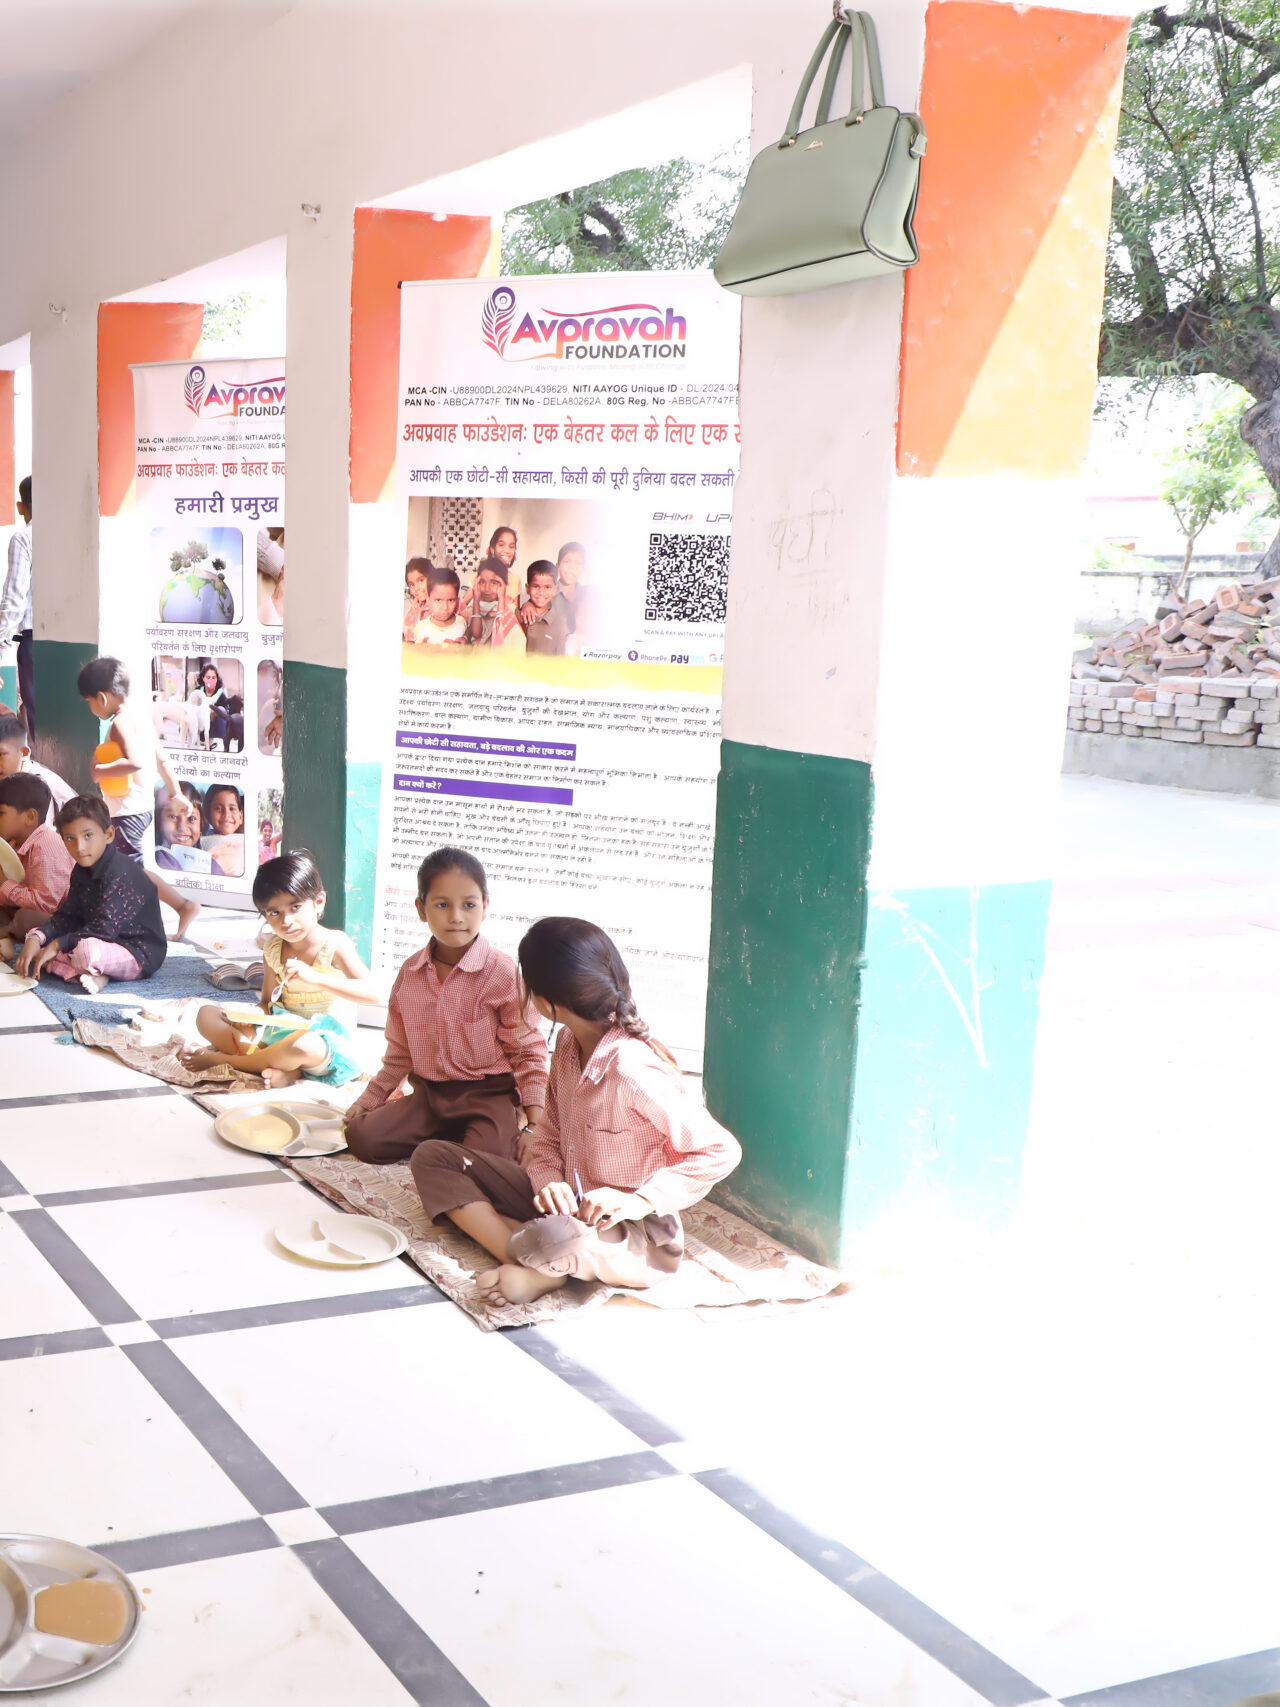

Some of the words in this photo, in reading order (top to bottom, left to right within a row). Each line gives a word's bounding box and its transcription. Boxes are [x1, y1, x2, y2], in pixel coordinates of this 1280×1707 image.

[511, 307, 687, 359] Avpravah
[565, 343, 686, 360] FOUNDATION
[408, 387, 427, 395] MCA
[573, 385, 591, 393] NITI
[593, 385, 628, 393] AAYOG
[631, 385, 665, 394] Unique
[667, 385, 678, 393] ID
[204, 383, 285, 416] Avprav
[405, 398, 421, 406] PAN
[424, 398, 435, 406] No
[505, 397, 520, 406] TIN
[522, 398, 534, 406] No
[606, 397, 625, 405] 80G
[628, 397, 649, 407] Reg.
[652, 397, 665, 405] No
[239, 406, 286, 417] FOUNDA
[403, 423, 458, 444] अवप्रवाह
[533, 423, 559, 444] एक
[563, 415, 606, 444] बेहतर
[610, 424, 639, 443] कल
[644, 415, 659, 443] के
[664, 415, 696, 445] लिए
[701, 424, 729, 445] एक
[137, 464, 173, 479] अवप्रवाह
[222, 463, 238, 478] एक
[240, 456, 269, 477] बेहतर
[409, 465, 442, 483] आपकी
[445, 470, 463, 484] एक
[467, 465, 508, 484] छोटी-सी
[512, 471, 556, 487] सहायता,
[561, 466, 588, 485] किसी
[592, 466, 606, 485] की
[610, 467, 629, 491] पूरी
[633, 467, 666, 492] दुनिया
[670, 472, 697, 487] बदल
[701, 468, 735, 487] सकती
[174, 490, 225, 515] हमारी
[230, 496, 279, 521] प्रमुख
[652, 512, 689, 521] BHIM
[588, 651, 622, 660] Razorpay
[440, 738, 449, 747] सी
